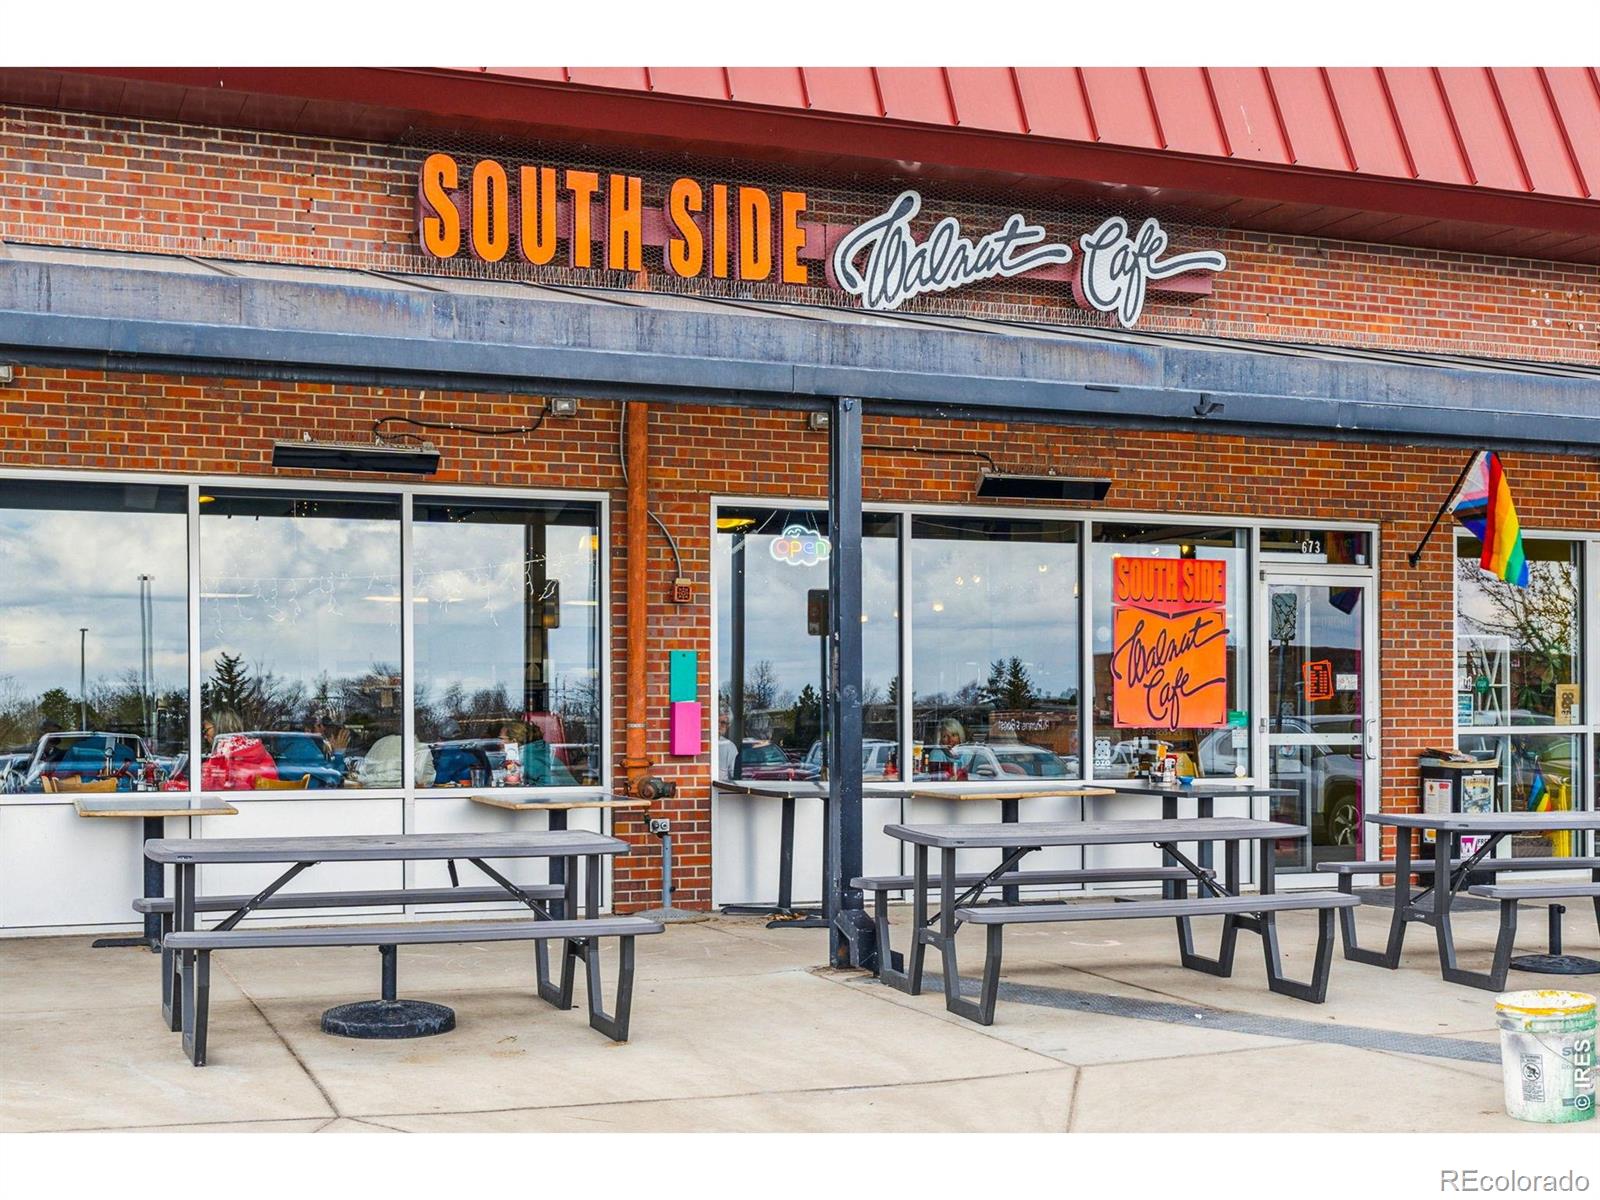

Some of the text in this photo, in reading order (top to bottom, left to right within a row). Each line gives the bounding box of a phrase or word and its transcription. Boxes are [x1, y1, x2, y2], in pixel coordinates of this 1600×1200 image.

[423, 153, 1227, 328] SOUTH SIDE Walnut Cafe
[1302, 540, 1321, 554] 673
[1117, 560, 1224, 604] SOUTH SIDE
[1110, 616, 1230, 688] Walnut
[1143, 667, 1225, 732] Cafe
